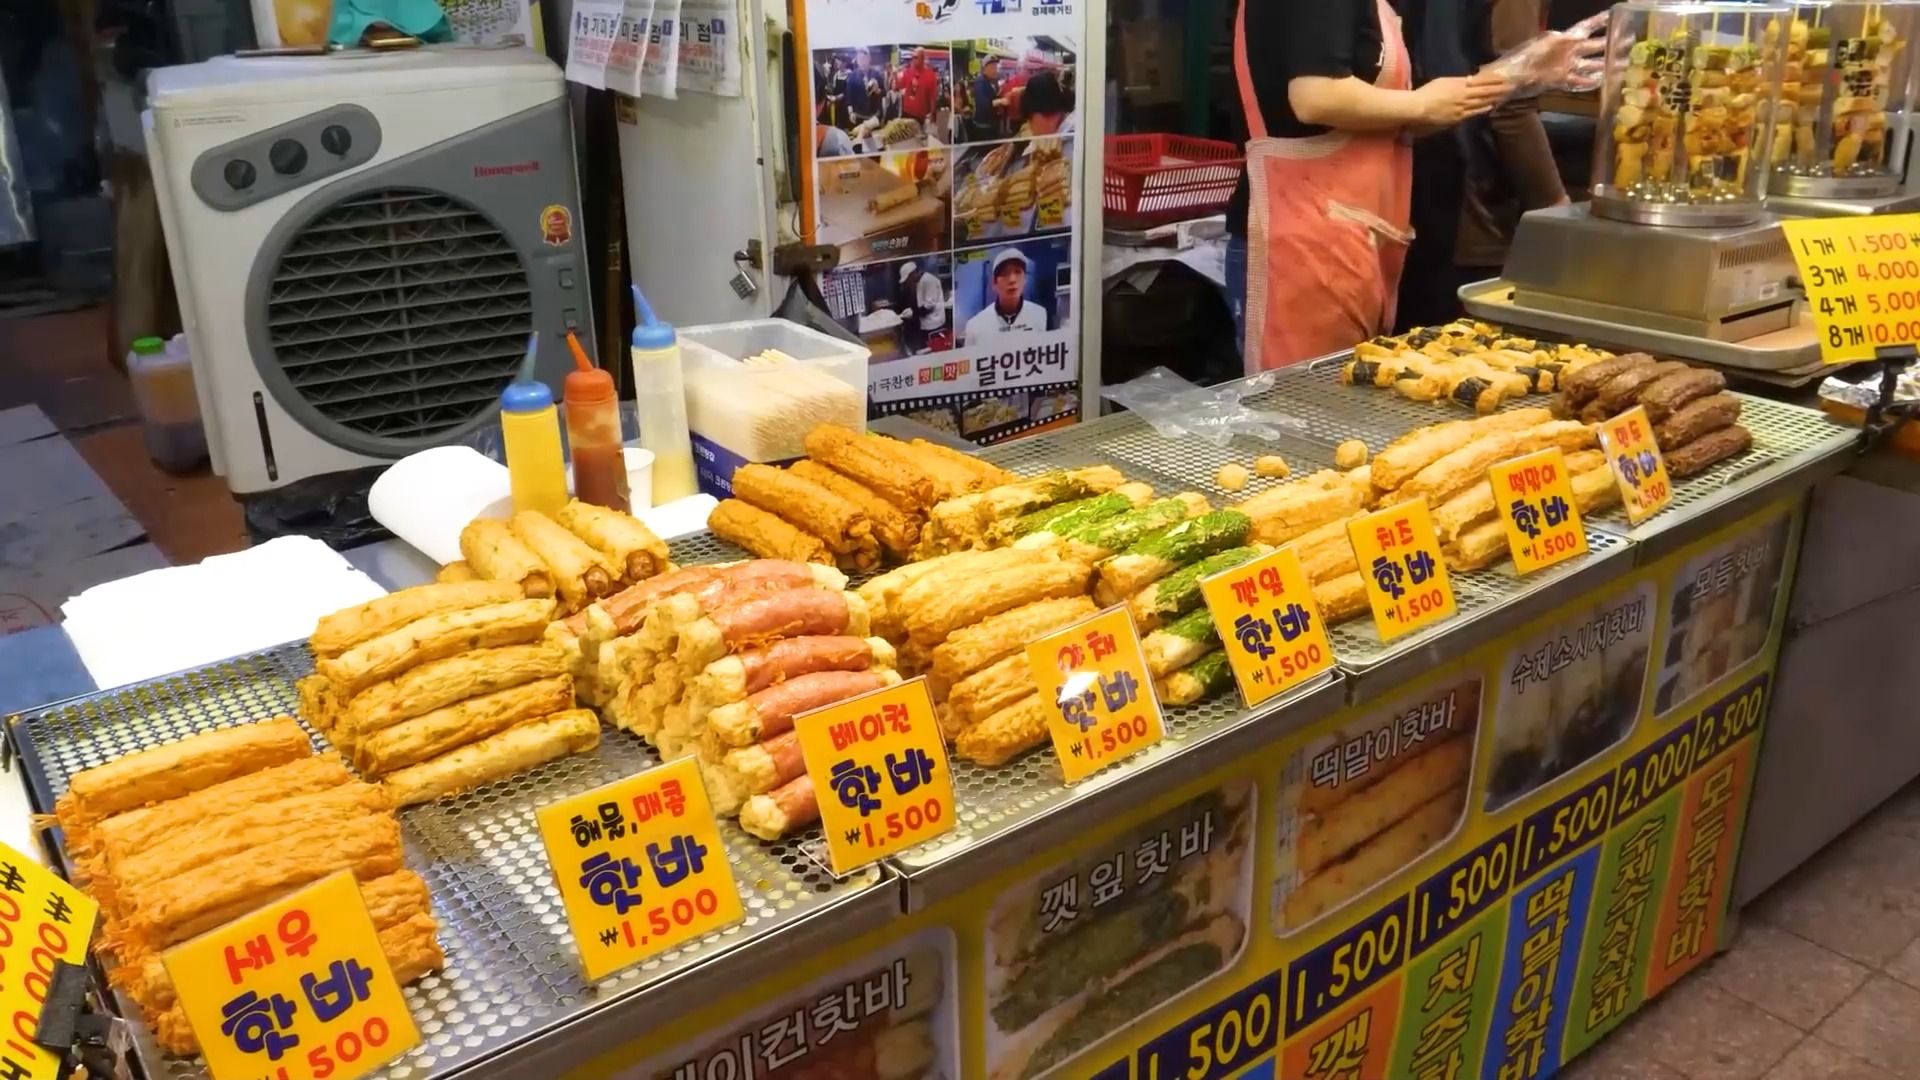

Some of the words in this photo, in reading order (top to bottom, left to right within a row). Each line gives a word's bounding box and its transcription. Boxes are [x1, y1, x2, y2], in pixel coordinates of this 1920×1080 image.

[1809, 264, 1847, 287] 3개
[1819, 294, 1858, 317] 4개
[1828, 324, 1865, 348] 8개
[976, 341, 1069, 387] 달인핫바
[1508, 463, 1557, 496] 떡말이
[1376, 518, 1414, 551] 치즈
[1230, 566, 1285, 607] 깻잎
[1057, 630, 1117, 672] 야채
[1511, 594, 1647, 694] 수제소시지핫바
[828, 703, 912, 752] 베이컨
[1310, 689, 1457, 789] 떡말이핫바
[1664, 757, 1737, 971] 모듬핫바
[223, 908, 318, 986] 새우
